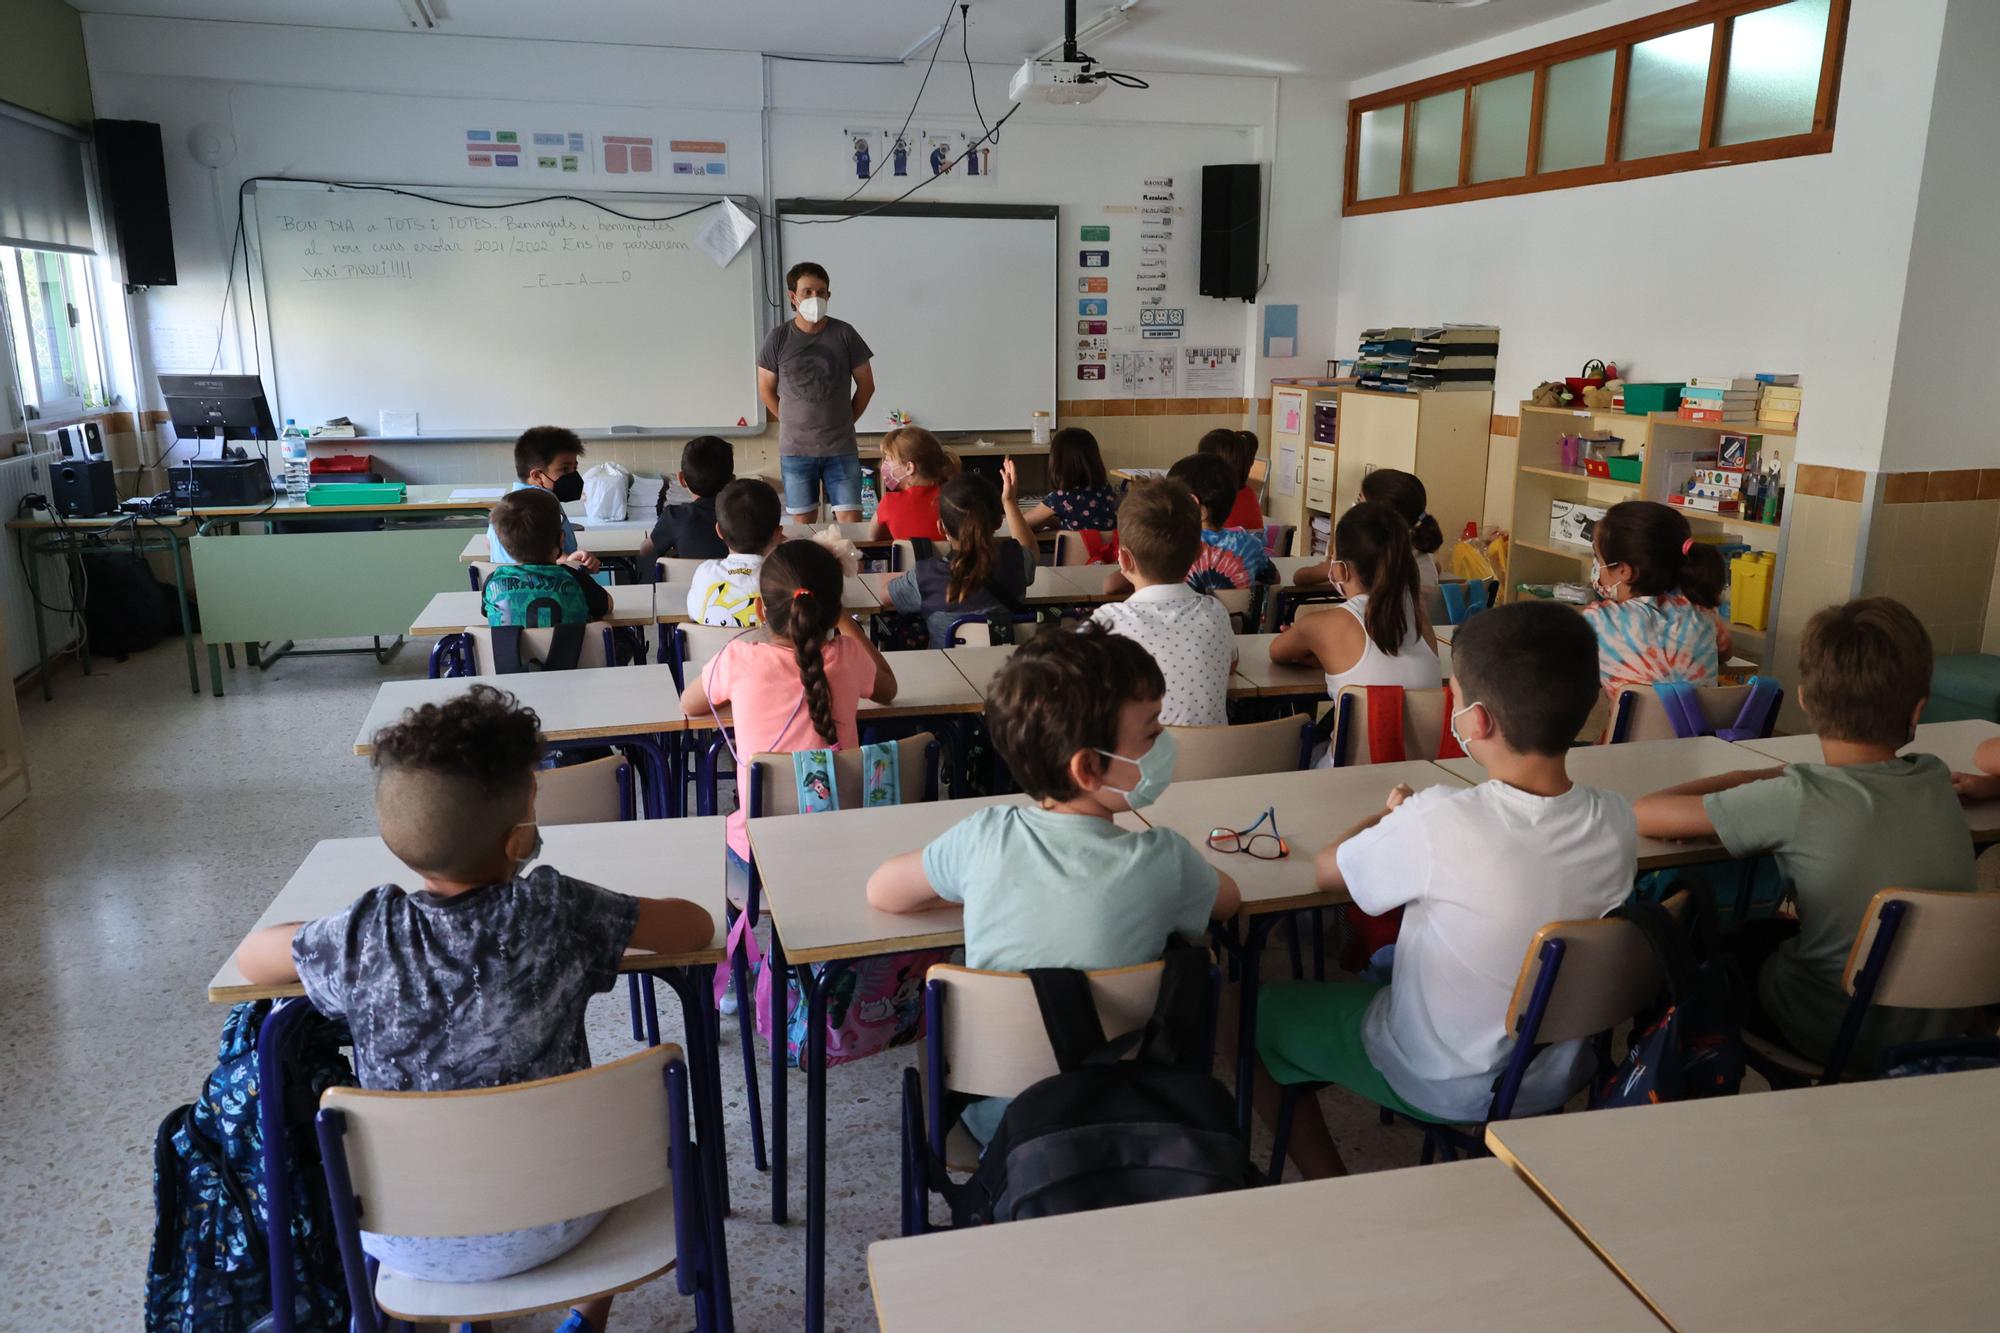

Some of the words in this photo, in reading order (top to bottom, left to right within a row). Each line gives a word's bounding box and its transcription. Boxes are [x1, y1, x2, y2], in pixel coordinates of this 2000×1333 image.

[283, 215, 317, 233] BON
[325, 218, 355, 233] DIA
[367, 224, 379, 232] a
[384, 216, 425, 231] TOTS
[562, 237, 593, 251] Ens
